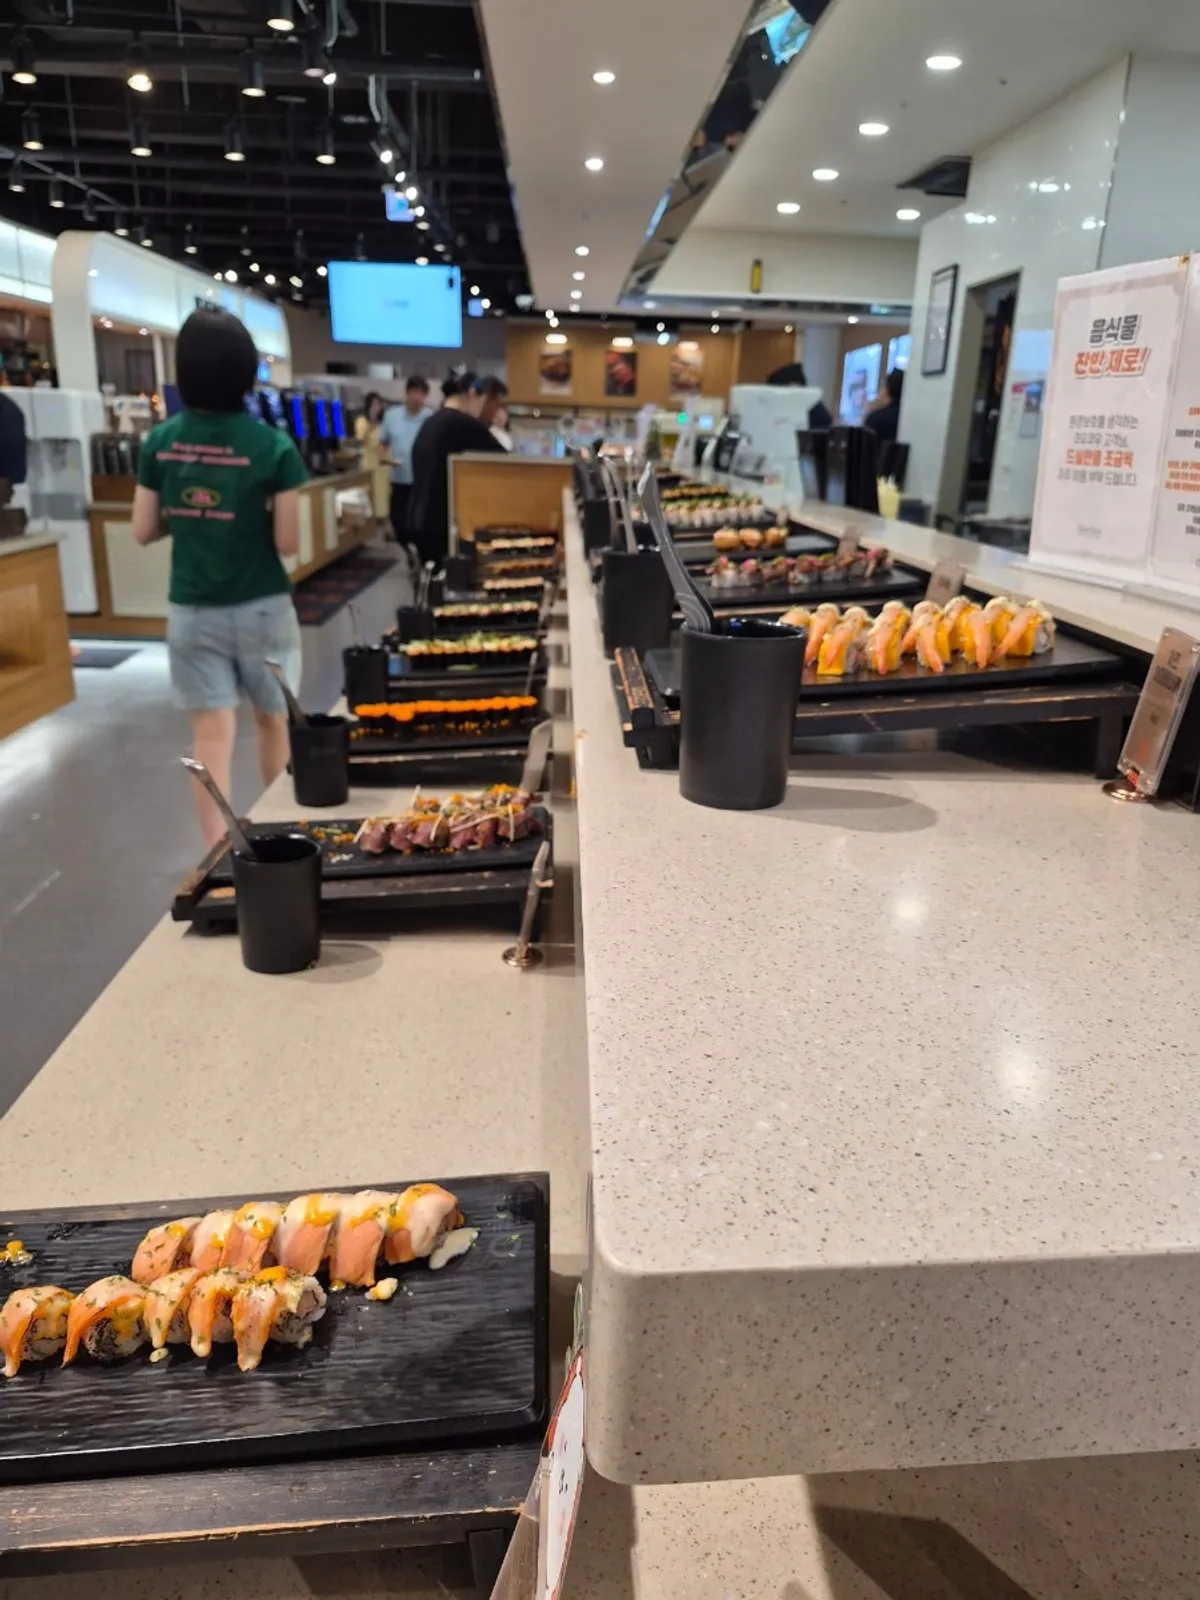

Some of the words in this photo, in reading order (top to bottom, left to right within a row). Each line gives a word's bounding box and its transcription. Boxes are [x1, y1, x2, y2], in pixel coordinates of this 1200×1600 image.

[1089, 314, 1138, 344] 음식물
[1074, 350, 1105, 376] 잔반
[1106, 347, 1149, 373] 제로!
